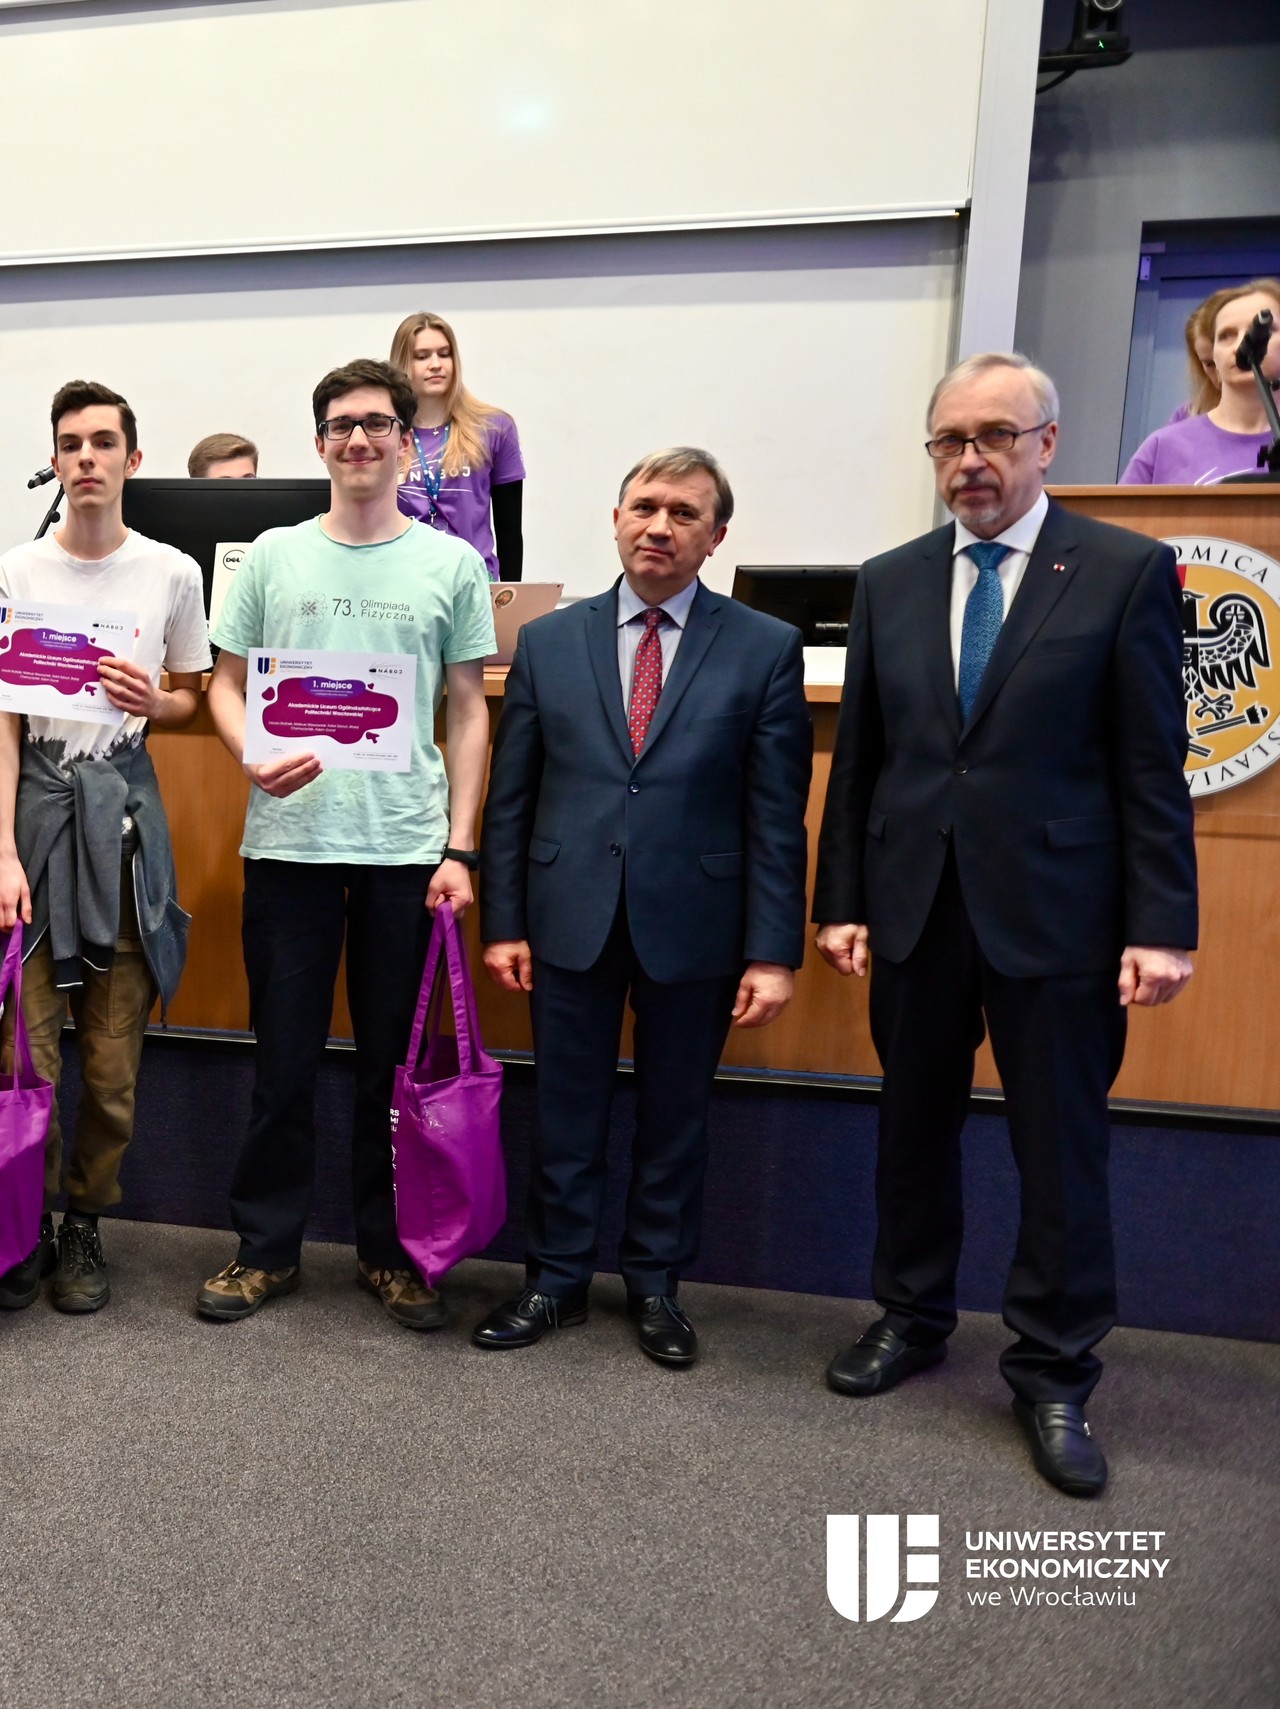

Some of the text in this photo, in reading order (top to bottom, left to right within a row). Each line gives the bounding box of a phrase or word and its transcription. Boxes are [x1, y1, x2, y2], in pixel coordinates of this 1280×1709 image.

[332, 598, 411, 618] 73. Olimpiada
[361, 608, 415, 622] Fizyczna
[49, 633, 77, 643] miejsce
[312, 680, 352, 690] 1. miejsce
